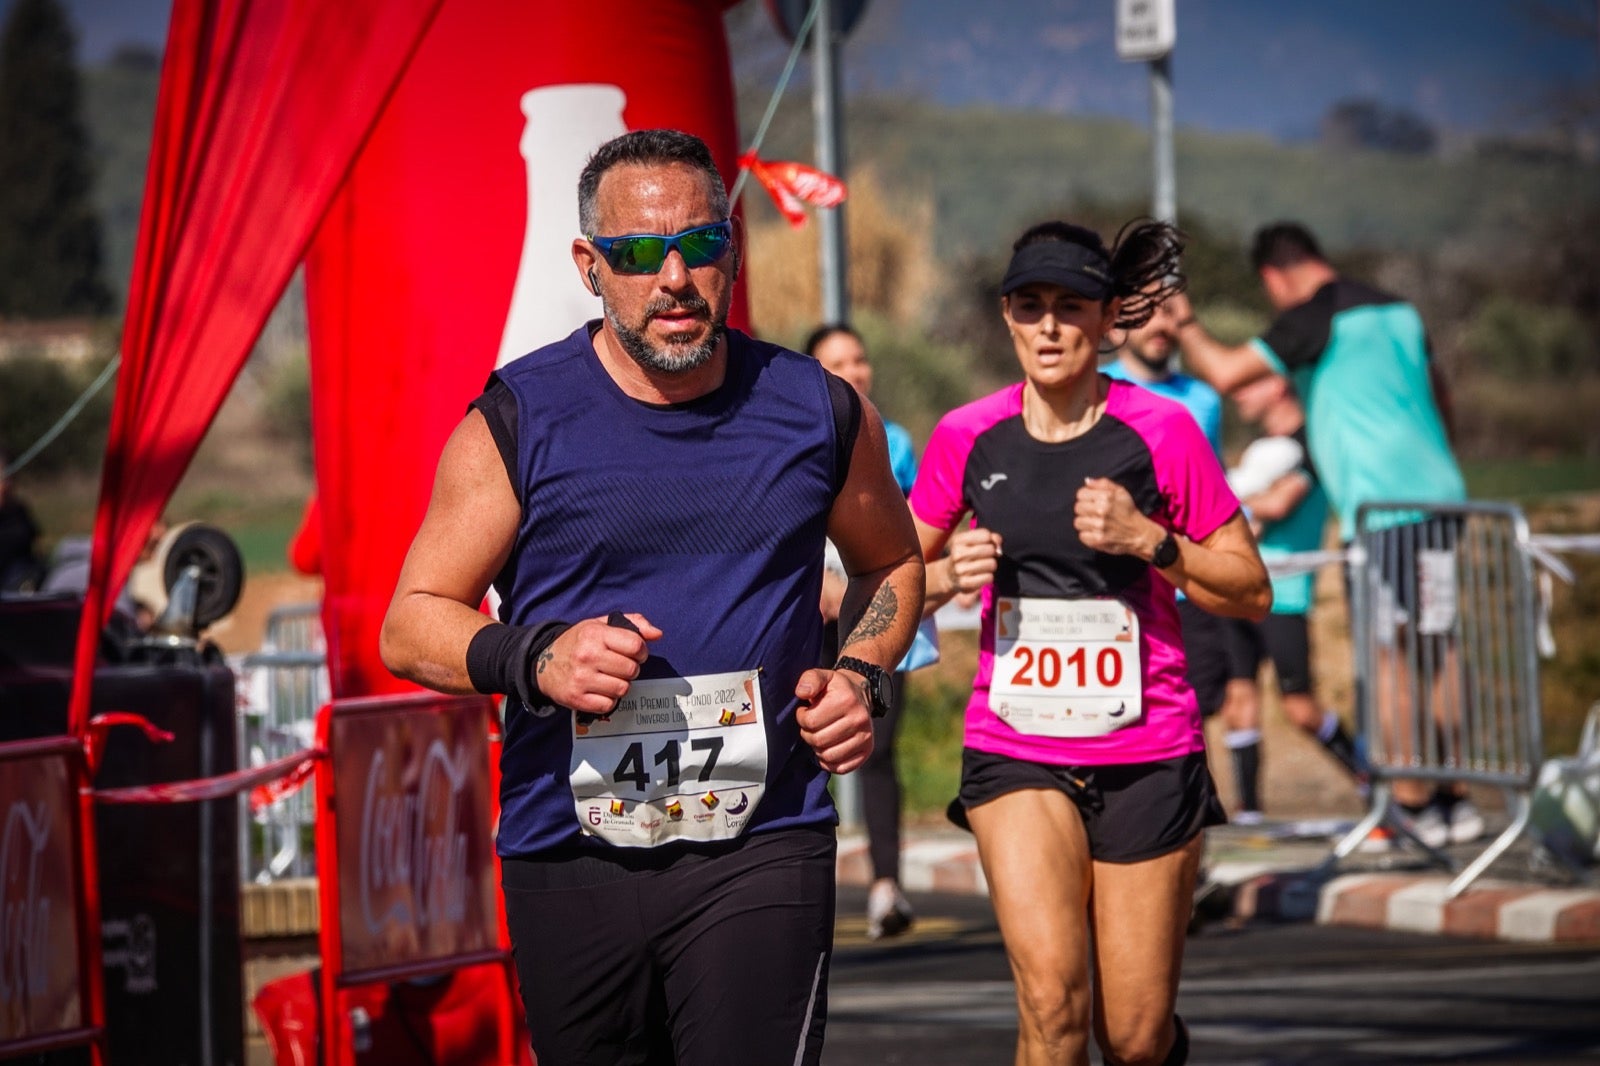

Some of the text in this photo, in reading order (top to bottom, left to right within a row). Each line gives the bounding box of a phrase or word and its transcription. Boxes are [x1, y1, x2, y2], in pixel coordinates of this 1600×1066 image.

[1010, 646, 1123, 688] 2010
[617, 699, 638, 713] GRAN
[640, 695, 670, 710] PREMIO
[686, 694, 712, 707] FONDO
[714, 688, 736, 705] 2022
[636, 710, 694, 726] UNIVERSO LORCA
[612, 736, 725, 792] 417
[610, 818, 635, 826] Granada
